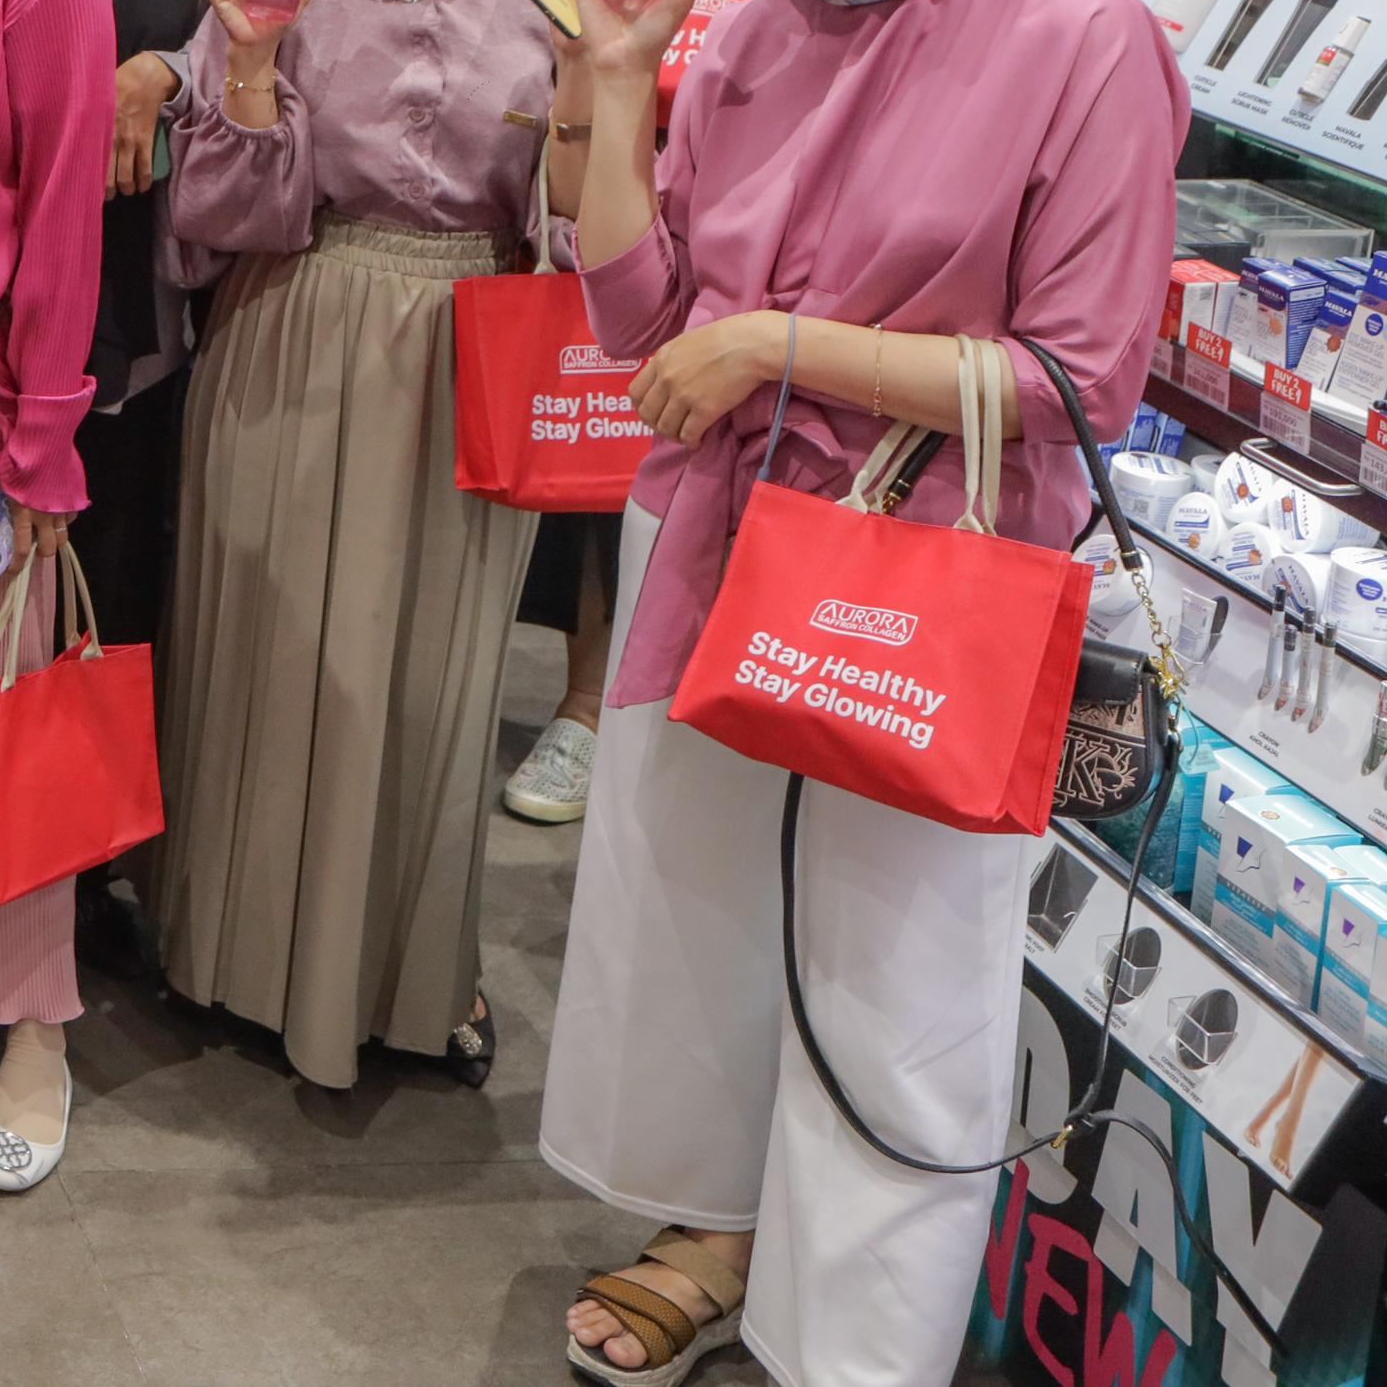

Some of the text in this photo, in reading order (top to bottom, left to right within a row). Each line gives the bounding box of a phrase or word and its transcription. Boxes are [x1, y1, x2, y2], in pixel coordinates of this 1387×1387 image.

[1335, 124, 1362, 139] MAVALA
[1324, 300, 1353, 318] MAVALA
[1197, 328, 1216, 343] BUY
[1194, 340, 1218, 358] FREE
[1273, 369, 1293, 384] BUY
[1270, 379, 1295, 399] FREE
[531, 394, 582, 418] Stay
[531, 417, 655, 444] Stay Glowi
[817, 614, 907, 642] SAFFRON COLLAGEN
[820, 602, 909, 635] AURORA
[747, 631, 947, 717] Stay Healthy
[734, 660, 935, 750] Stay Glowing
